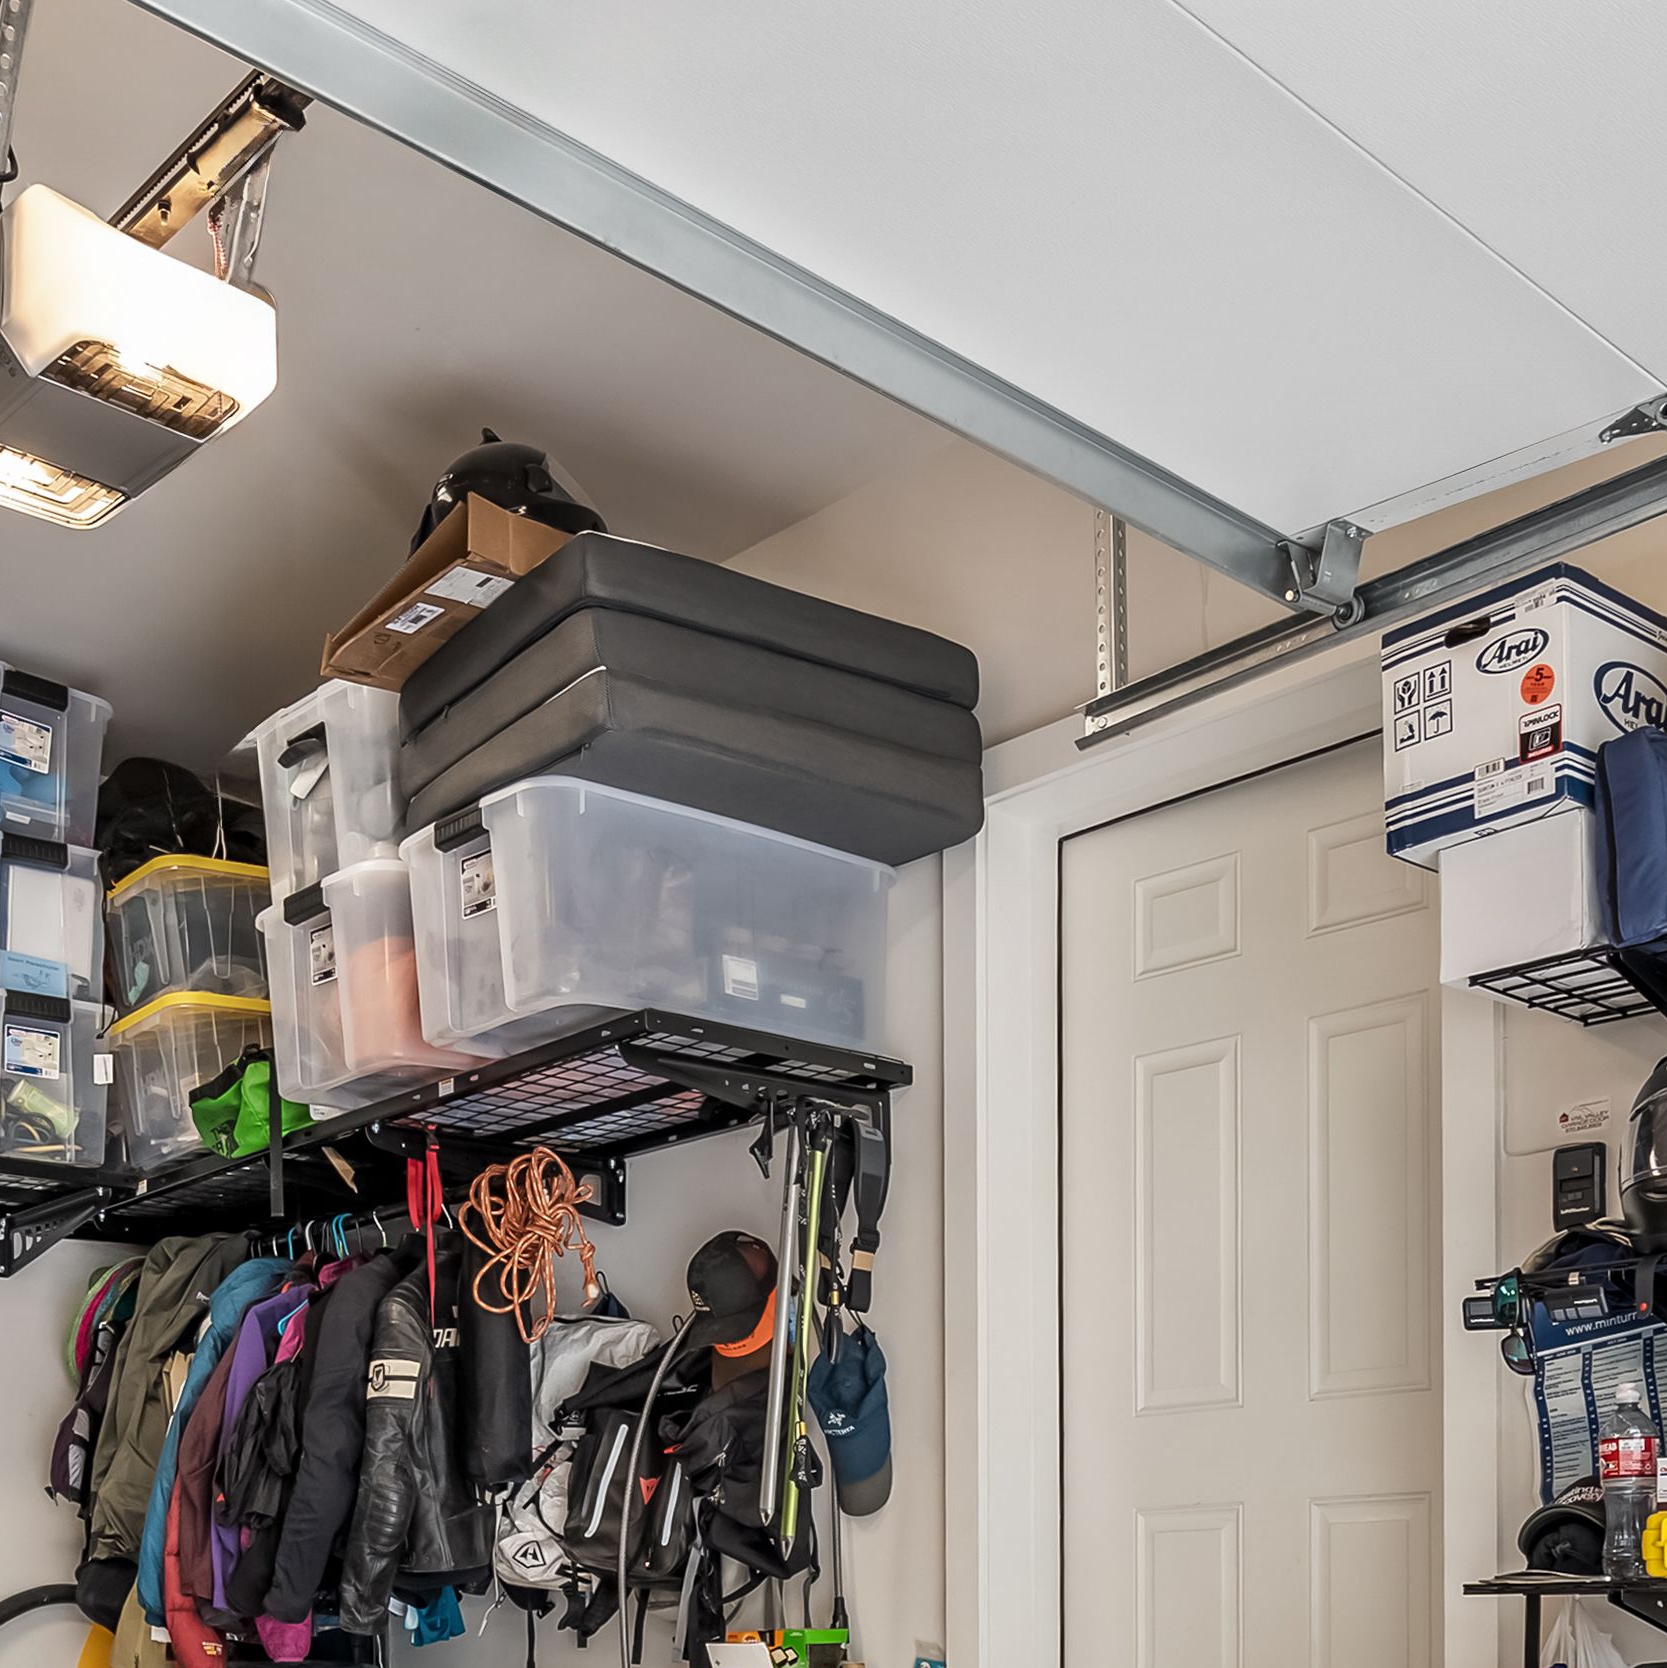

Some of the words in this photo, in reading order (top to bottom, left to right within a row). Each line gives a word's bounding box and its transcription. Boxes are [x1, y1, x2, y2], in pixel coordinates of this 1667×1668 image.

[1481, 630, 1539, 669] Arai
[1534, 668, 1543, 682] 5
[1583, 1110, 1609, 1120] VALLEY
